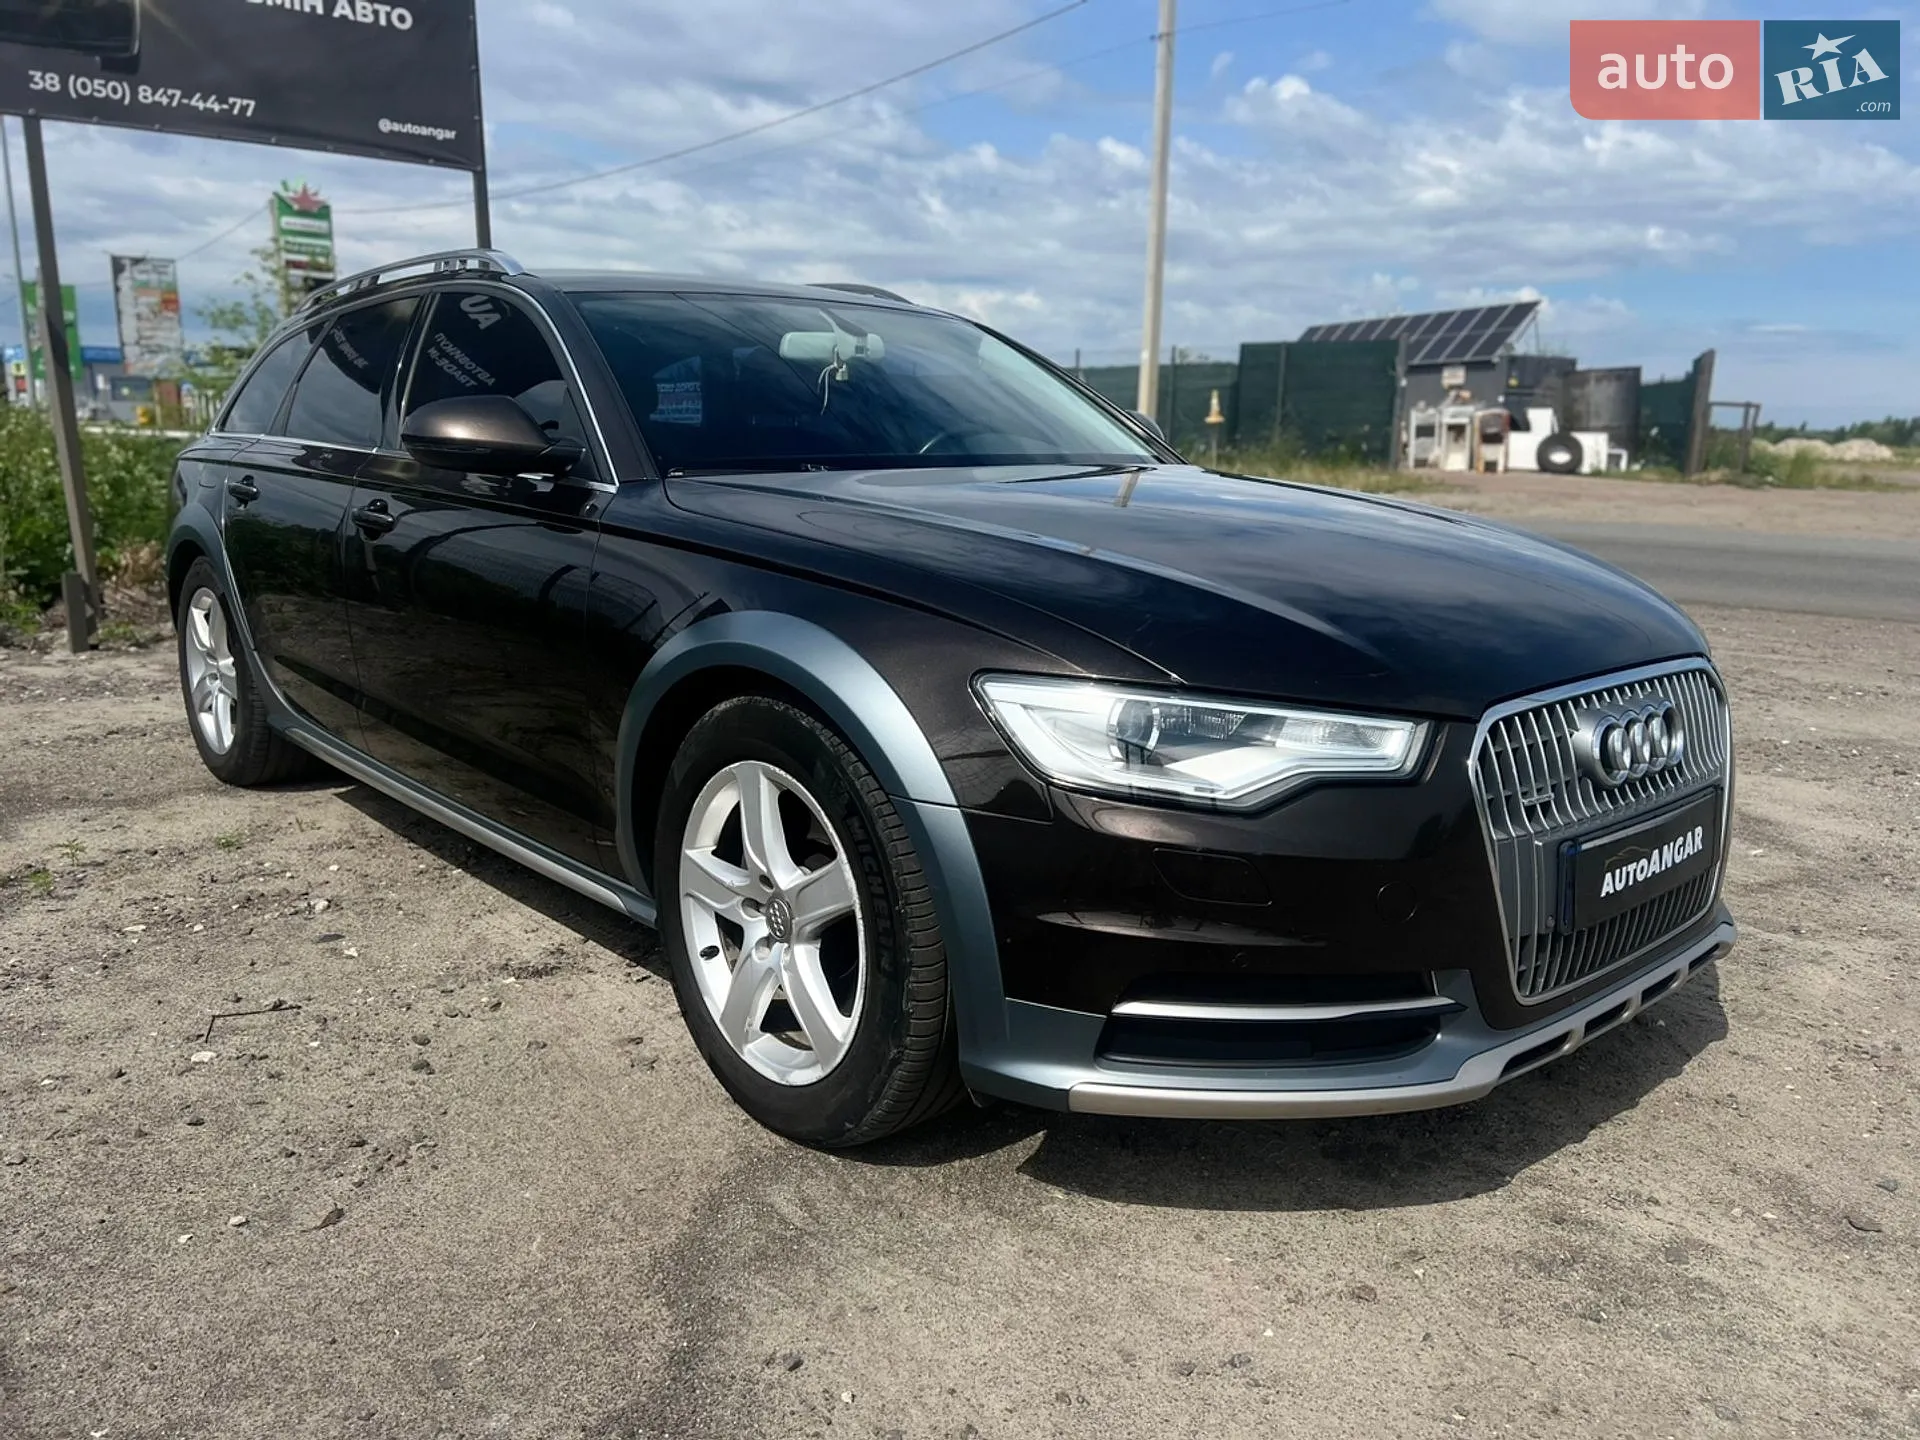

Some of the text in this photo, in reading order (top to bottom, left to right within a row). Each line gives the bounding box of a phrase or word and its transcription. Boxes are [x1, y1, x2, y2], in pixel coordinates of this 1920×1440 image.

[332, 0, 413, 30] АВТО
[28, 70, 256, 117] 38 (050) 847-44-77
[378, 118, 457, 141] @autoangar
[1600, 825, 1703, 898] AUTOANGAR
